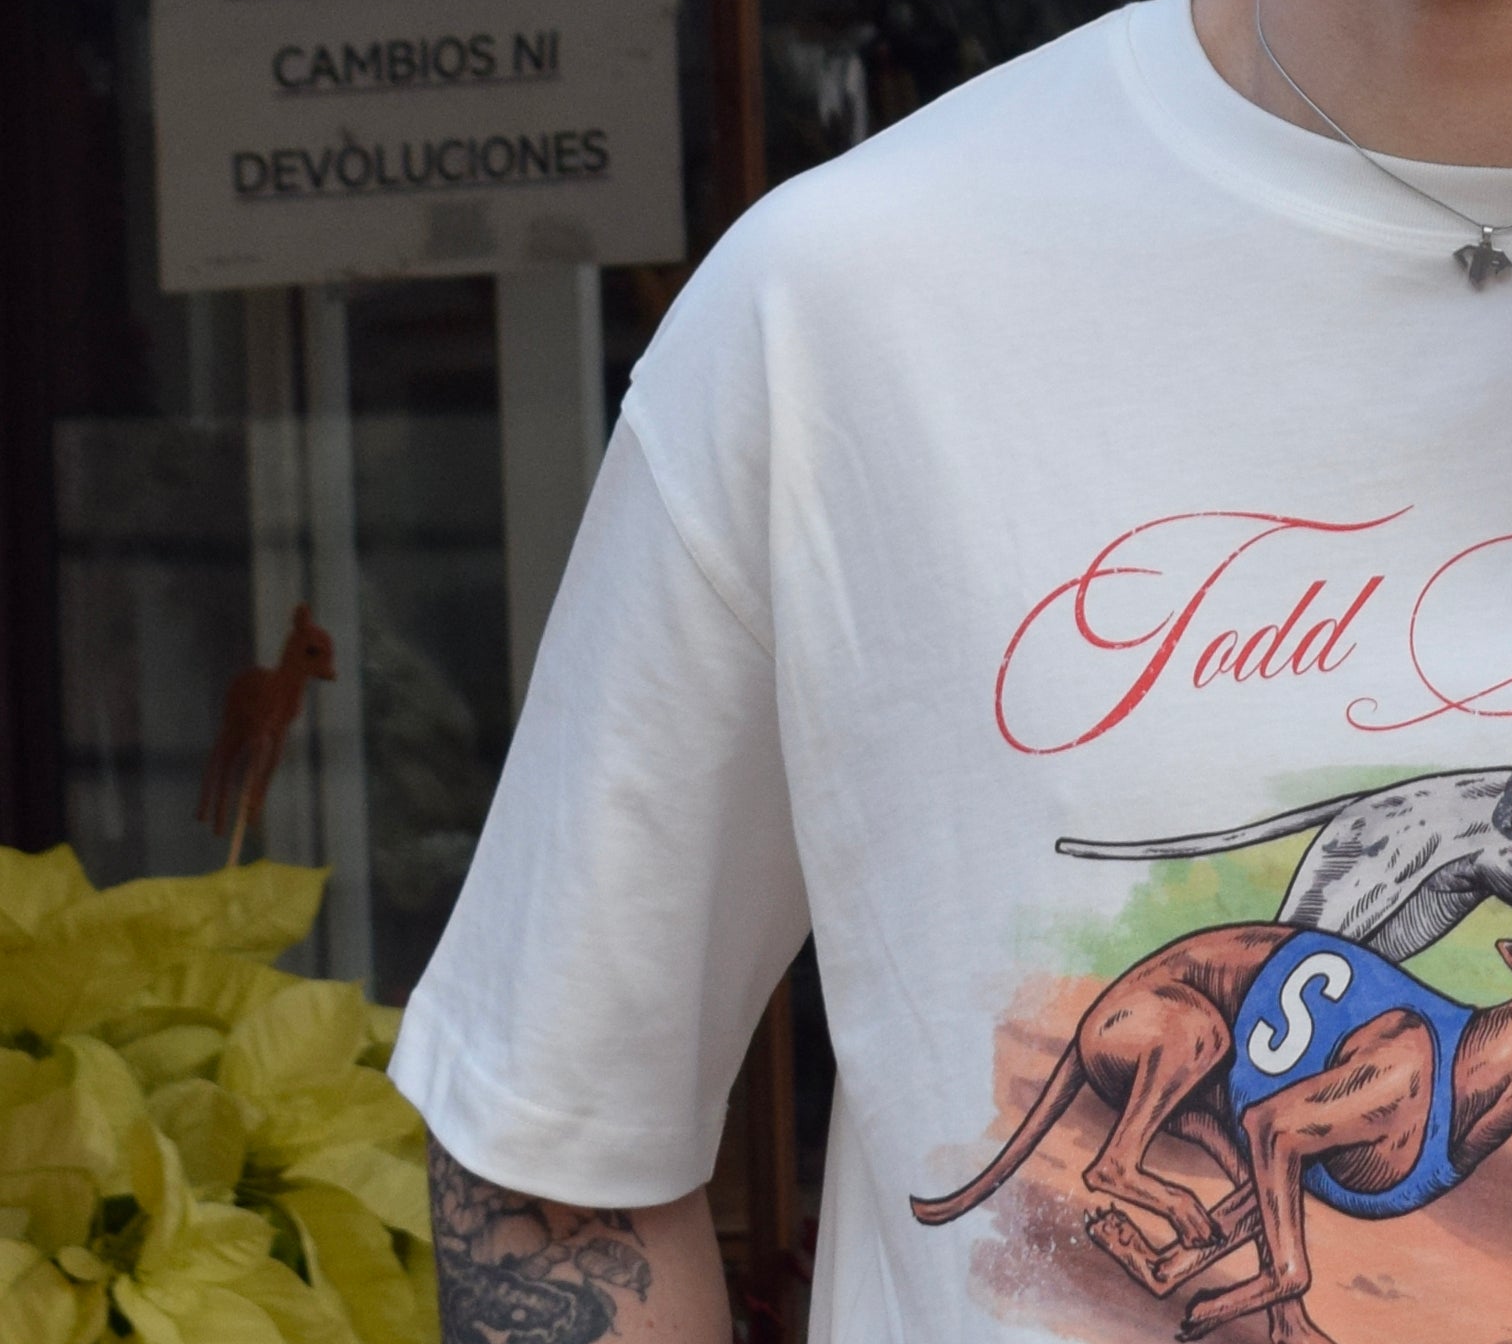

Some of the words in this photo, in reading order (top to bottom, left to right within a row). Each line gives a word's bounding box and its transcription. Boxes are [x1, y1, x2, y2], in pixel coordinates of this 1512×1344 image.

[272, 32, 498, 88] CAMBIOS
[512, 28, 561, 73] NI
[994, 504, 1414, 755] Todd
[1246, 951, 1354, 1076] S
